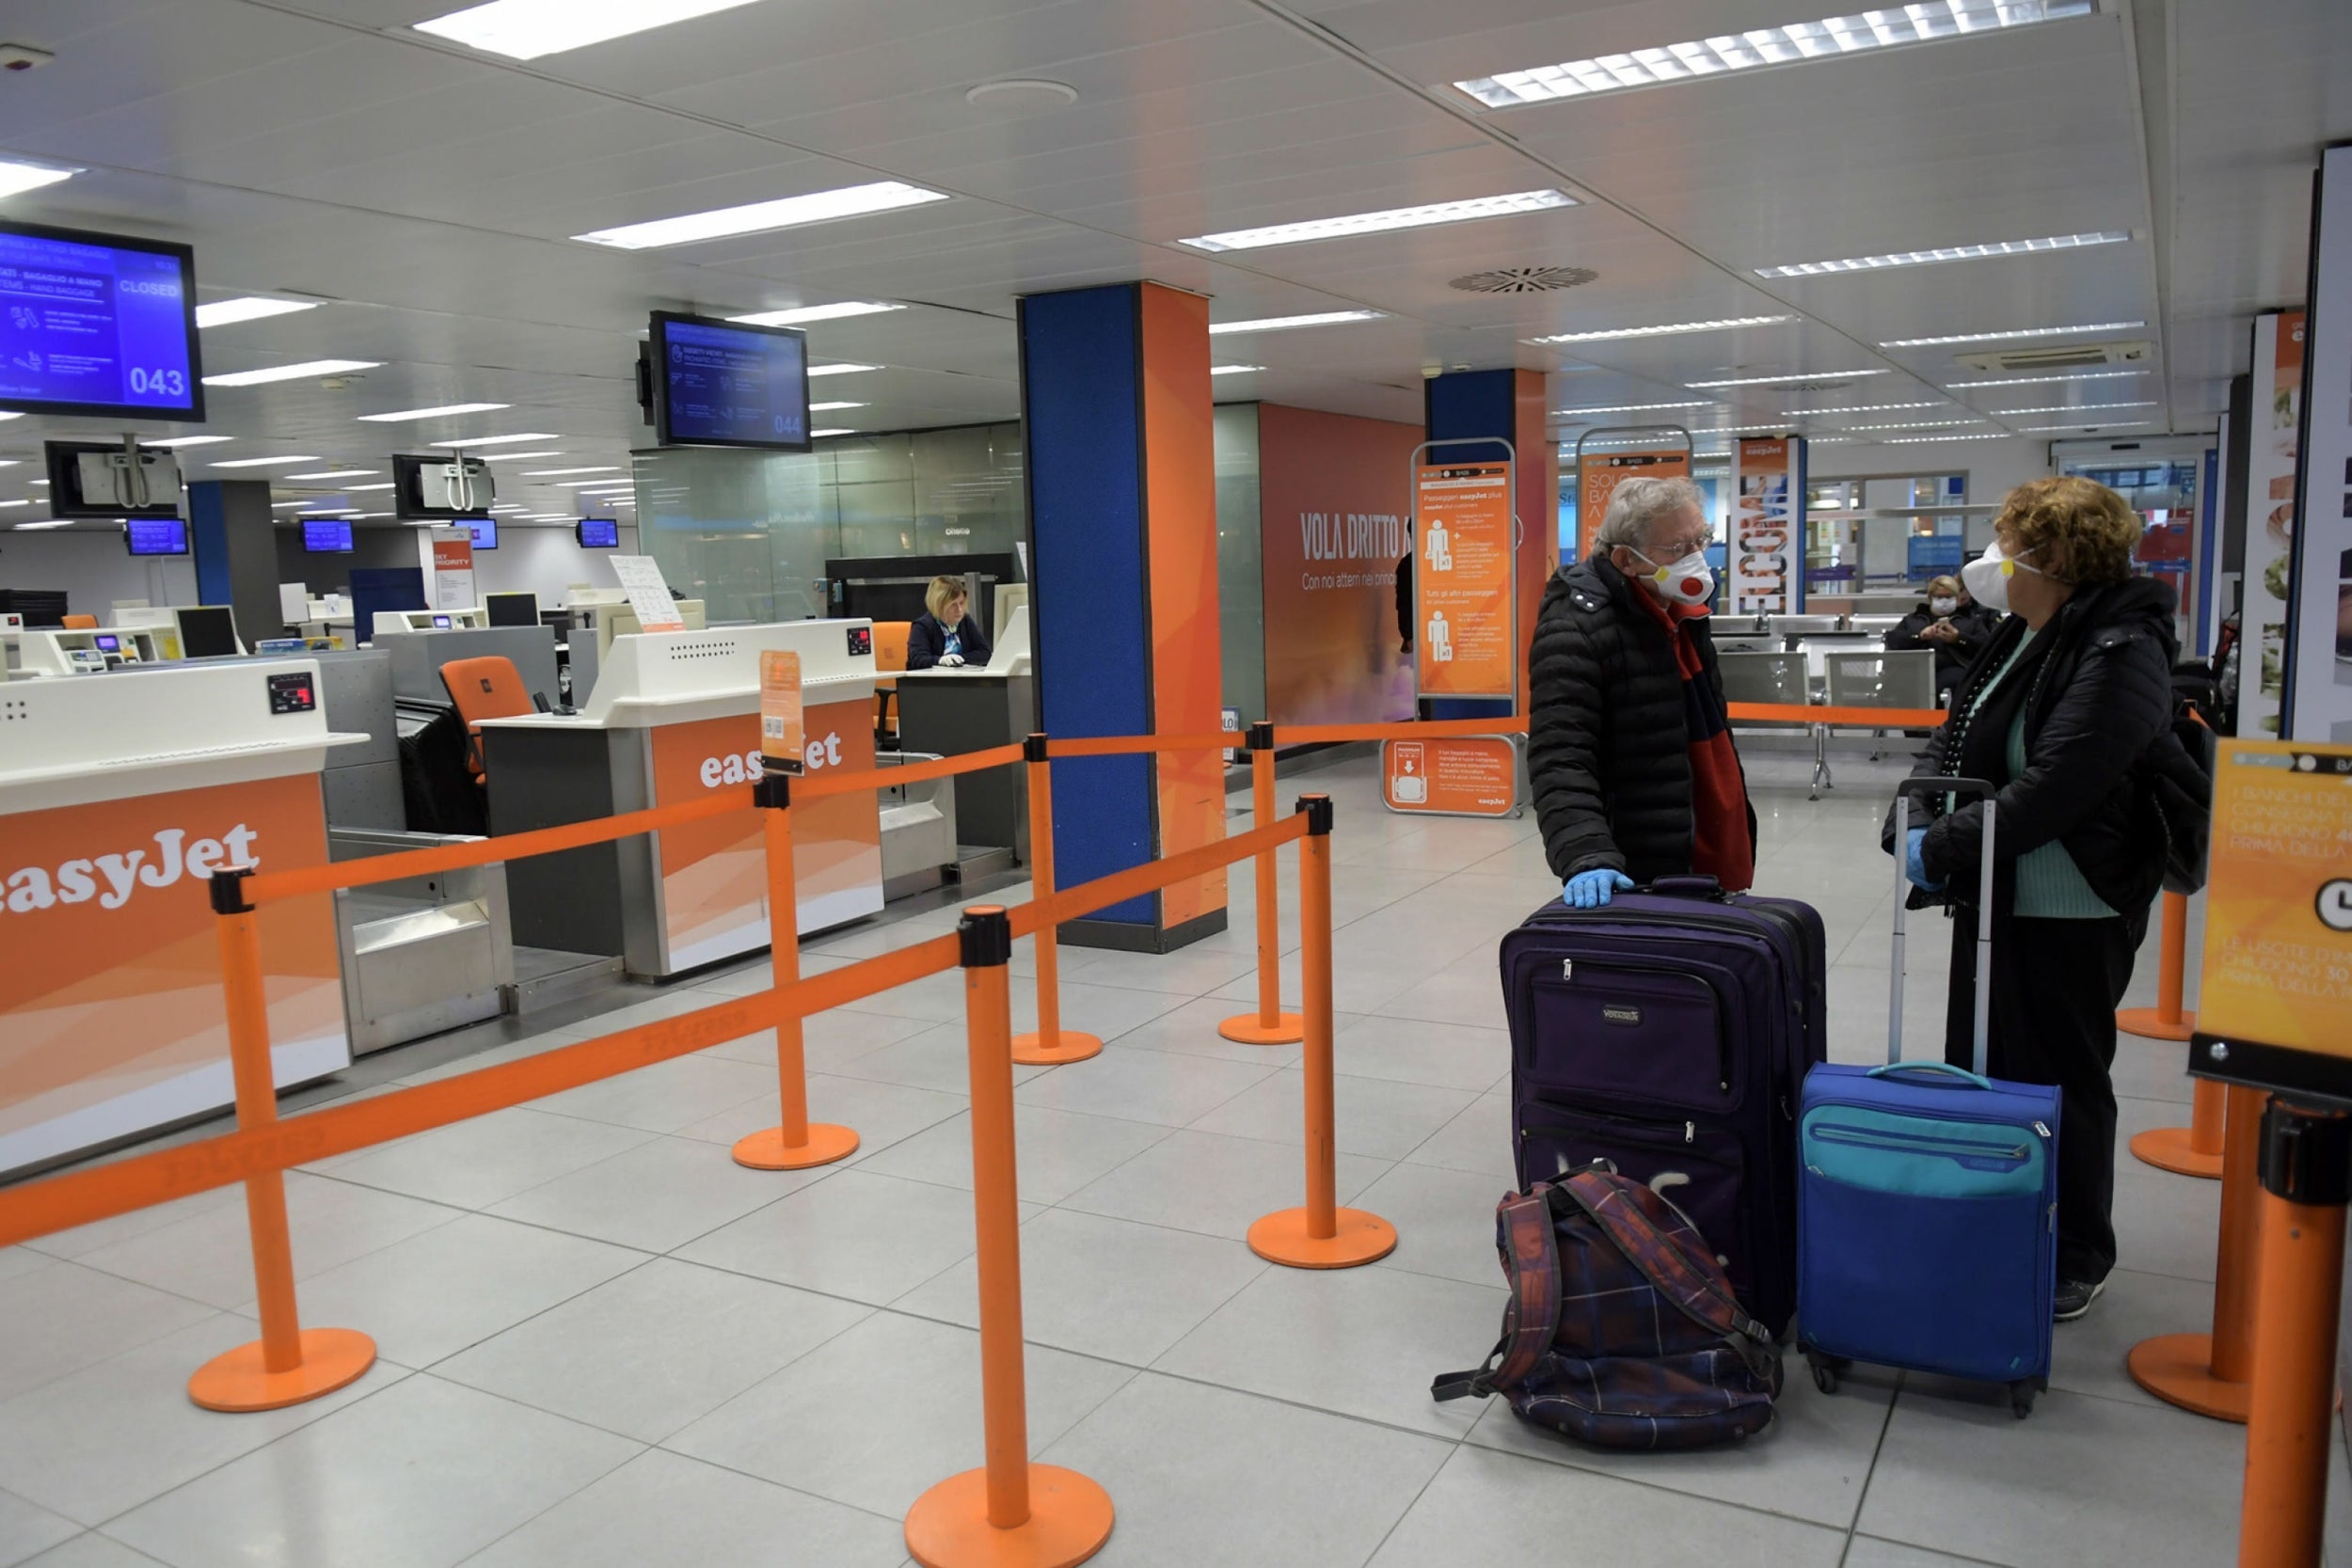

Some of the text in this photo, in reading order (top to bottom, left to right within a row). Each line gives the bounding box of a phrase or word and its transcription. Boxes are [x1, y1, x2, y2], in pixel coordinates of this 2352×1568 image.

[119, 279, 179, 297] CLOSED
[130, 367, 184, 396] 043
[774, 415, 801, 435] 044
[1300, 513, 1343, 560] VOLA
[1347, 514, 1399, 559] DRITTO
[1301, 572, 1320, 591] Con
[1321, 572, 1335, 589] noi
[2242, 786, 2312, 804] BANCHI
[2231, 802, 2335, 825] CONSEGNA
[2231, 819, 2331, 841] CHIUDONO
[2231, 835, 2347, 859] PRIMA DELLA
[2248, 940, 2311, 961] USCITE
[2221, 948, 2349, 982] CHIUDONO 30
[2219, 967, 2275, 990] PRIMA
[2279, 976, 2336, 997] DELLA
